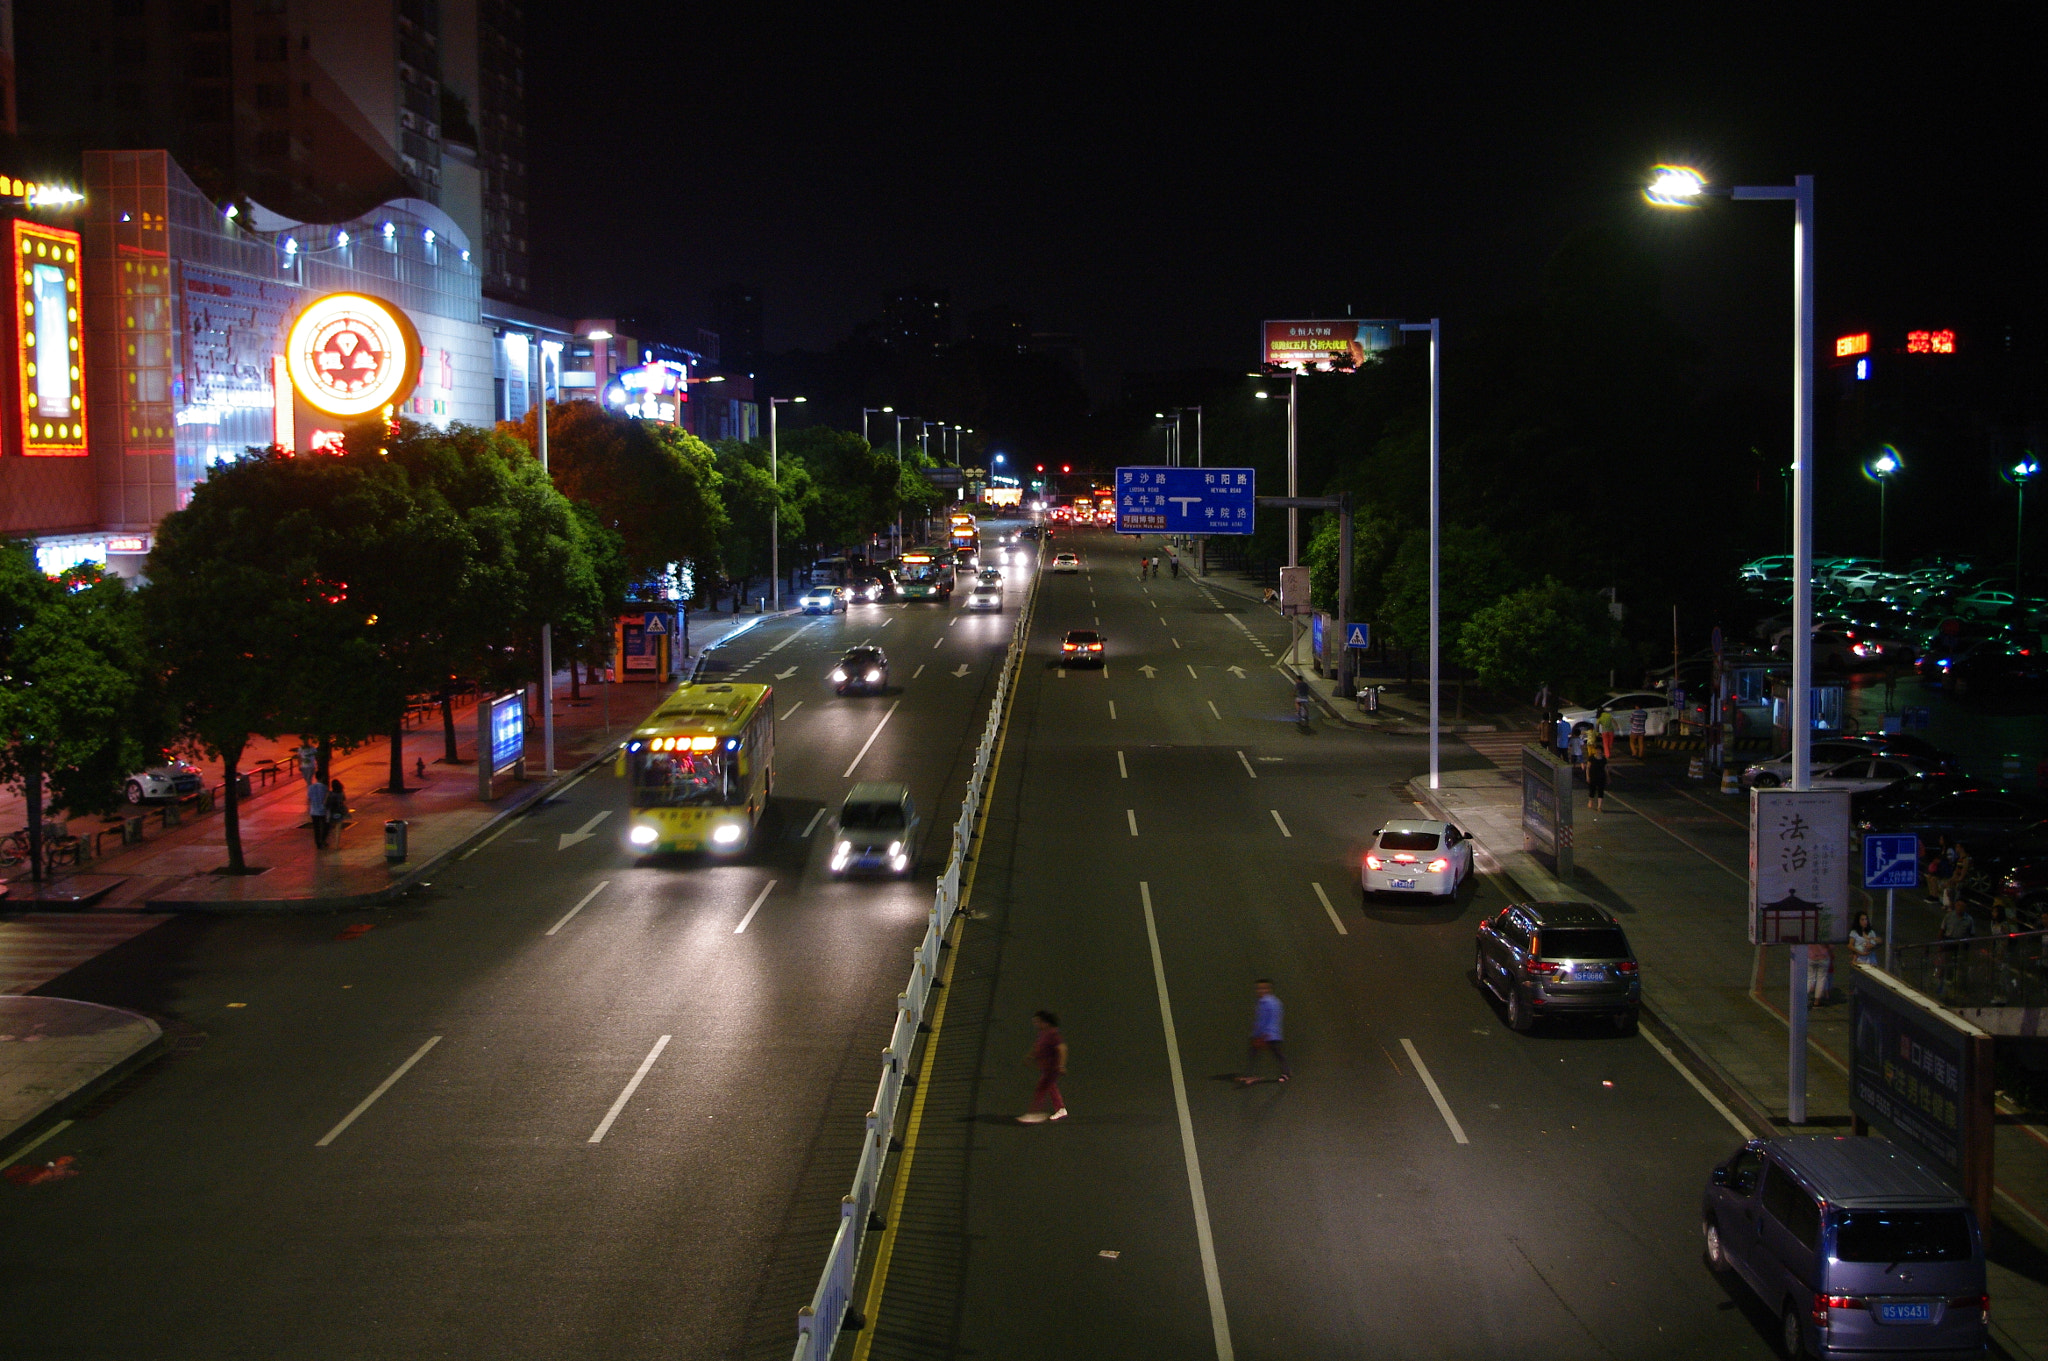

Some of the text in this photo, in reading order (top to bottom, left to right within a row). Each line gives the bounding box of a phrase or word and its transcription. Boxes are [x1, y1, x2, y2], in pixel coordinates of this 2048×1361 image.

[1123, 472, 1166, 485] 罗沙路
[1204, 473, 1247, 485] 和阳路
[1123, 495, 1166, 506] 金牛路
[1204, 506, 1247, 519] 学院路
[1123, 515, 1165, 524] 可园博物馆
[1779, 813, 1809, 873] 法治
